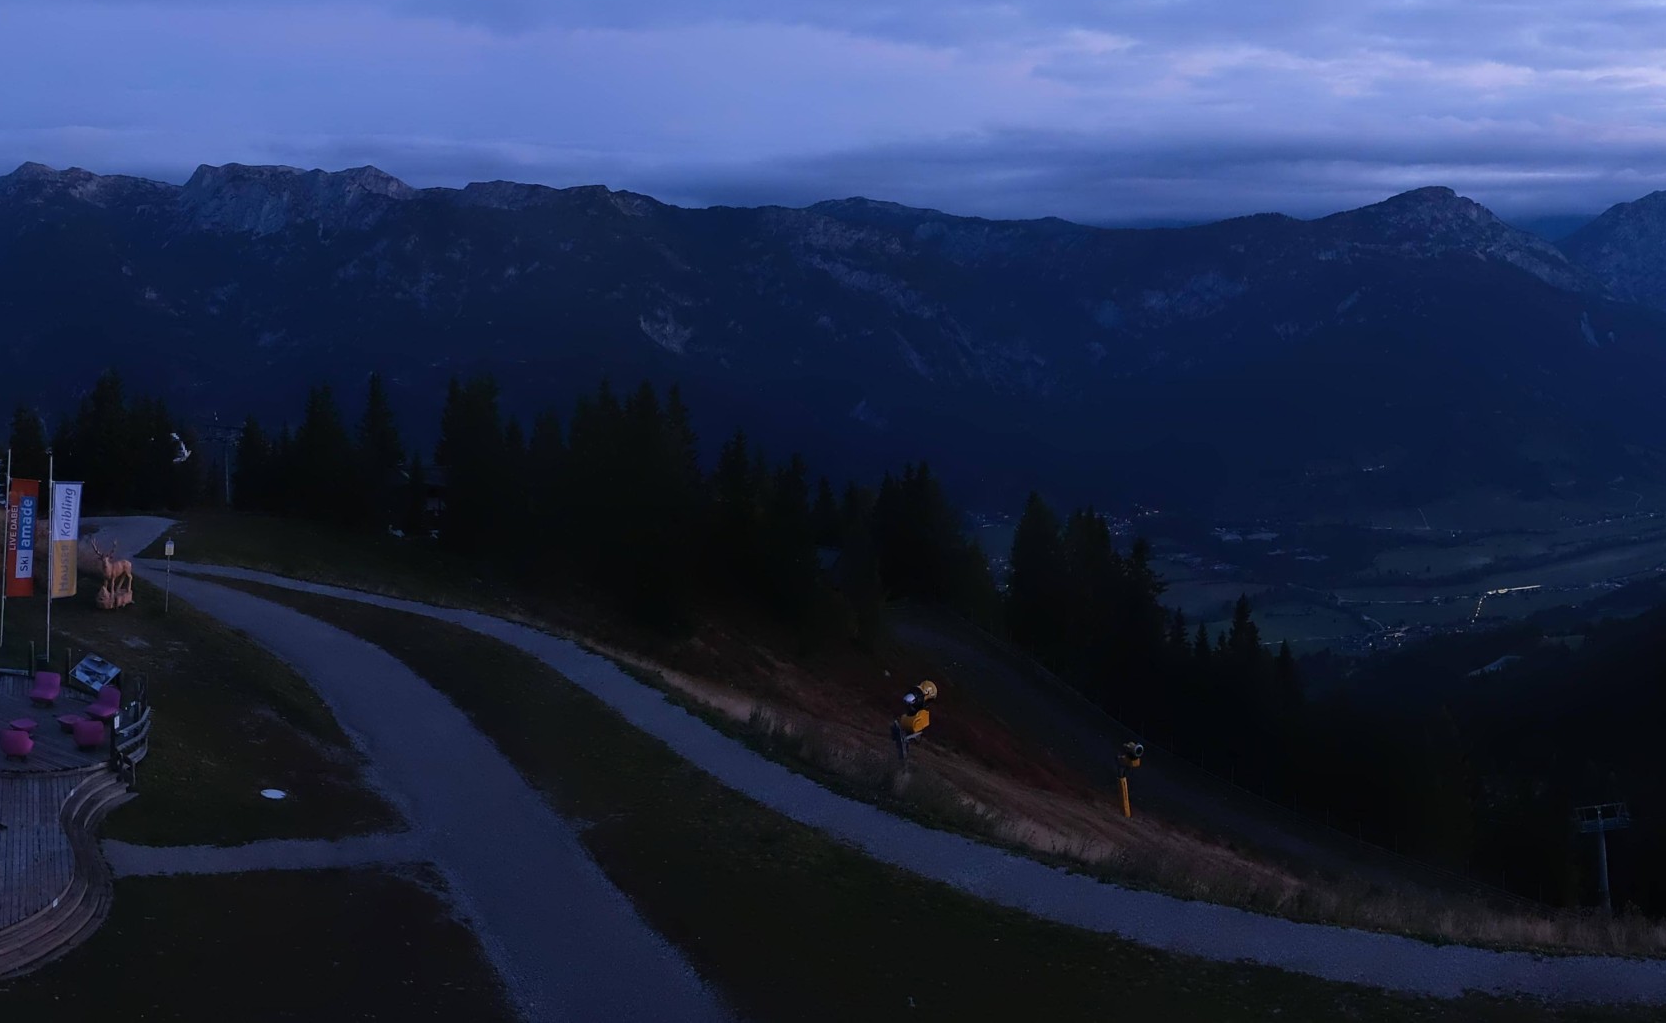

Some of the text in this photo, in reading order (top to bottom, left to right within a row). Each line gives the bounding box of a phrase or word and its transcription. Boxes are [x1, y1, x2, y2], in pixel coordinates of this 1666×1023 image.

[9, 504, 18, 551] LIVE DABEI
[61, 487, 76, 537] Kaibling
[20, 556, 29, 572] Ski
